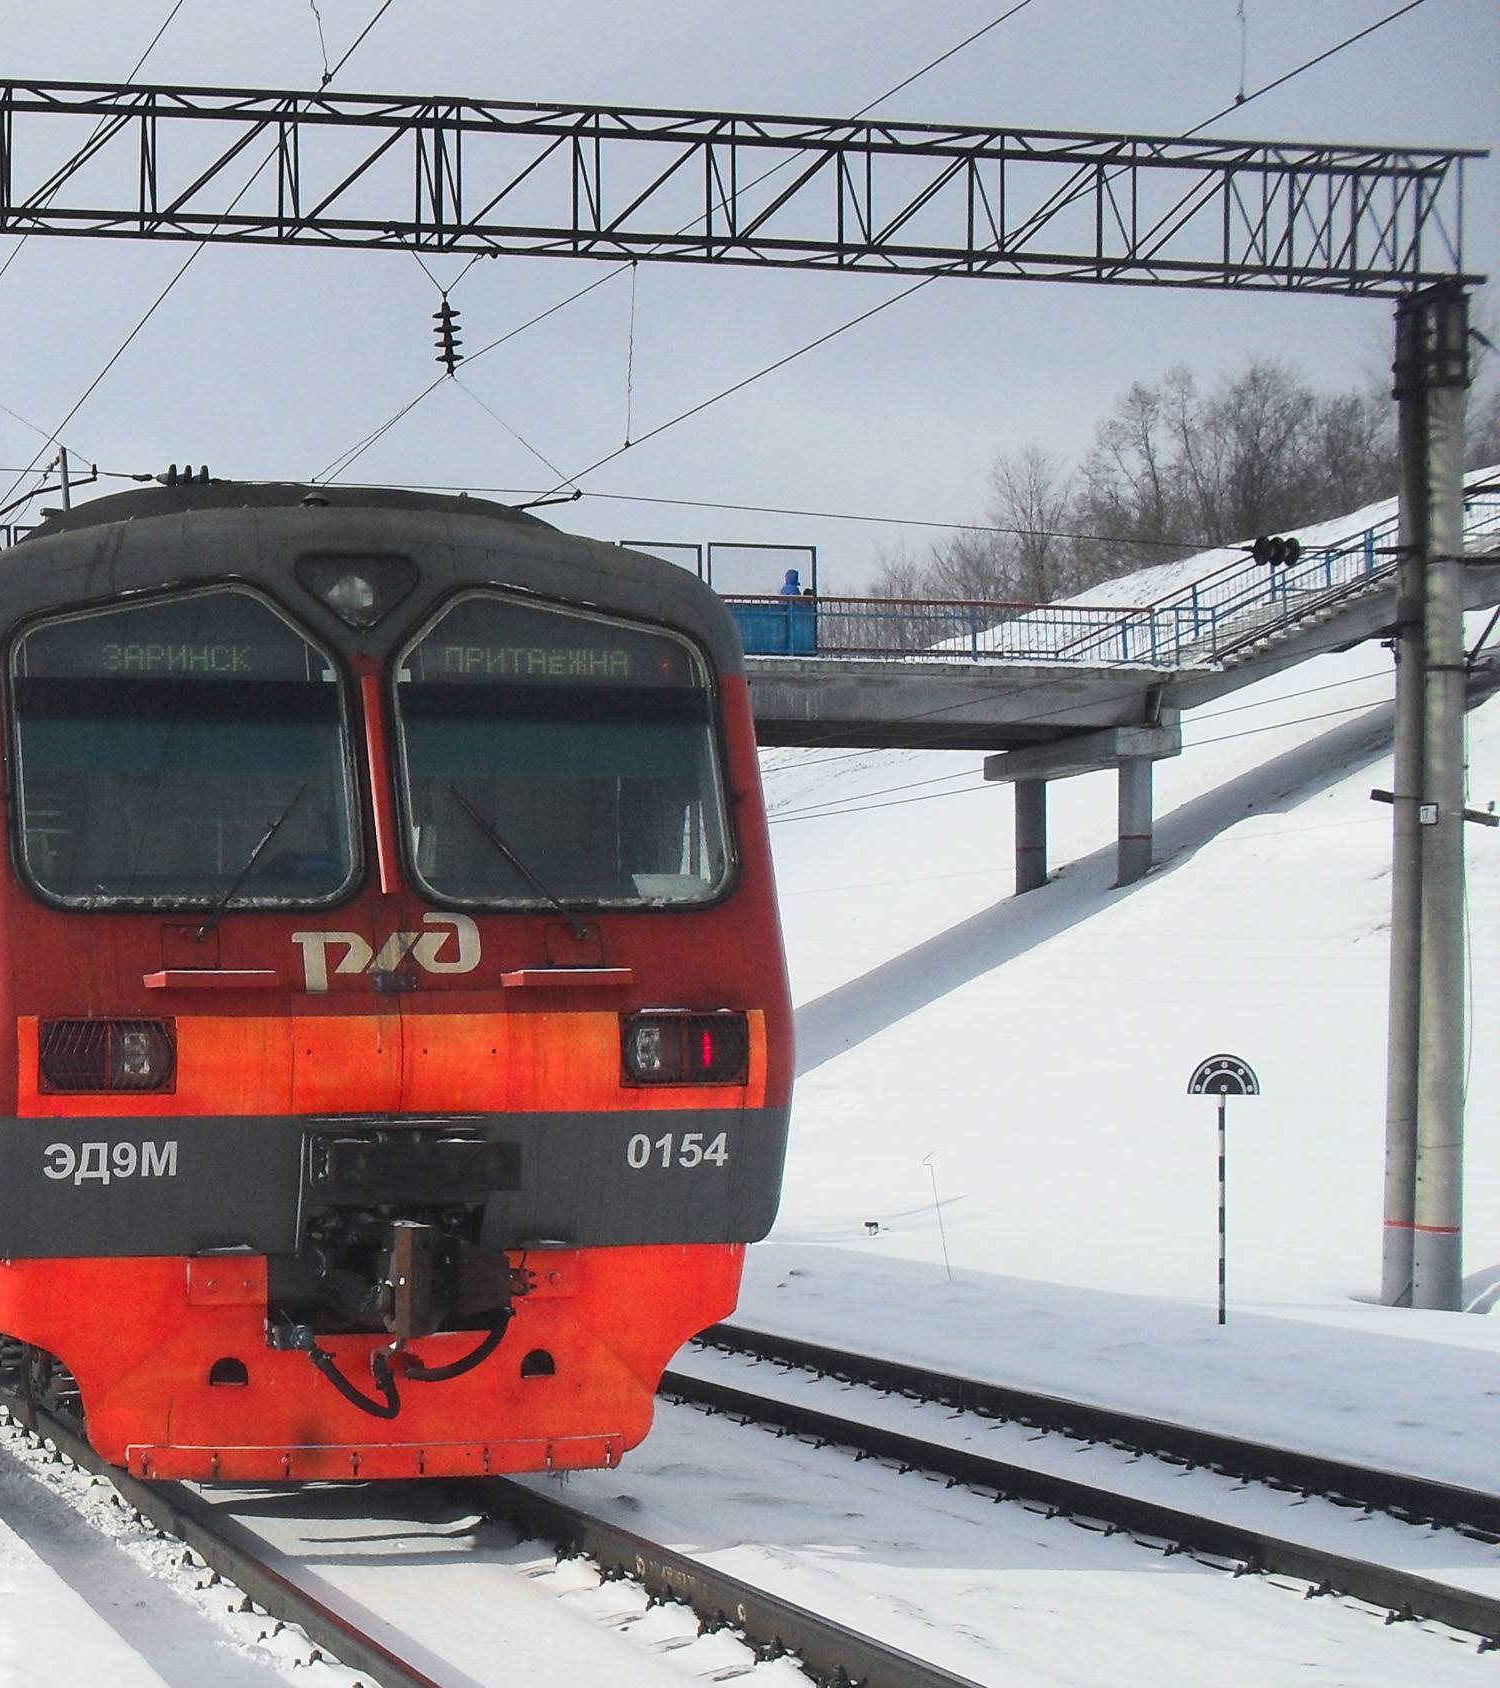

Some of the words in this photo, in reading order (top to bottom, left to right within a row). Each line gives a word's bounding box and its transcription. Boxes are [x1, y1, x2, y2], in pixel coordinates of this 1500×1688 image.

[102, 644, 251, 671] ЗАРИНСК
[43, 1141, 178, 1185] ЭД9М
[627, 1132, 728, 1168] 0154
